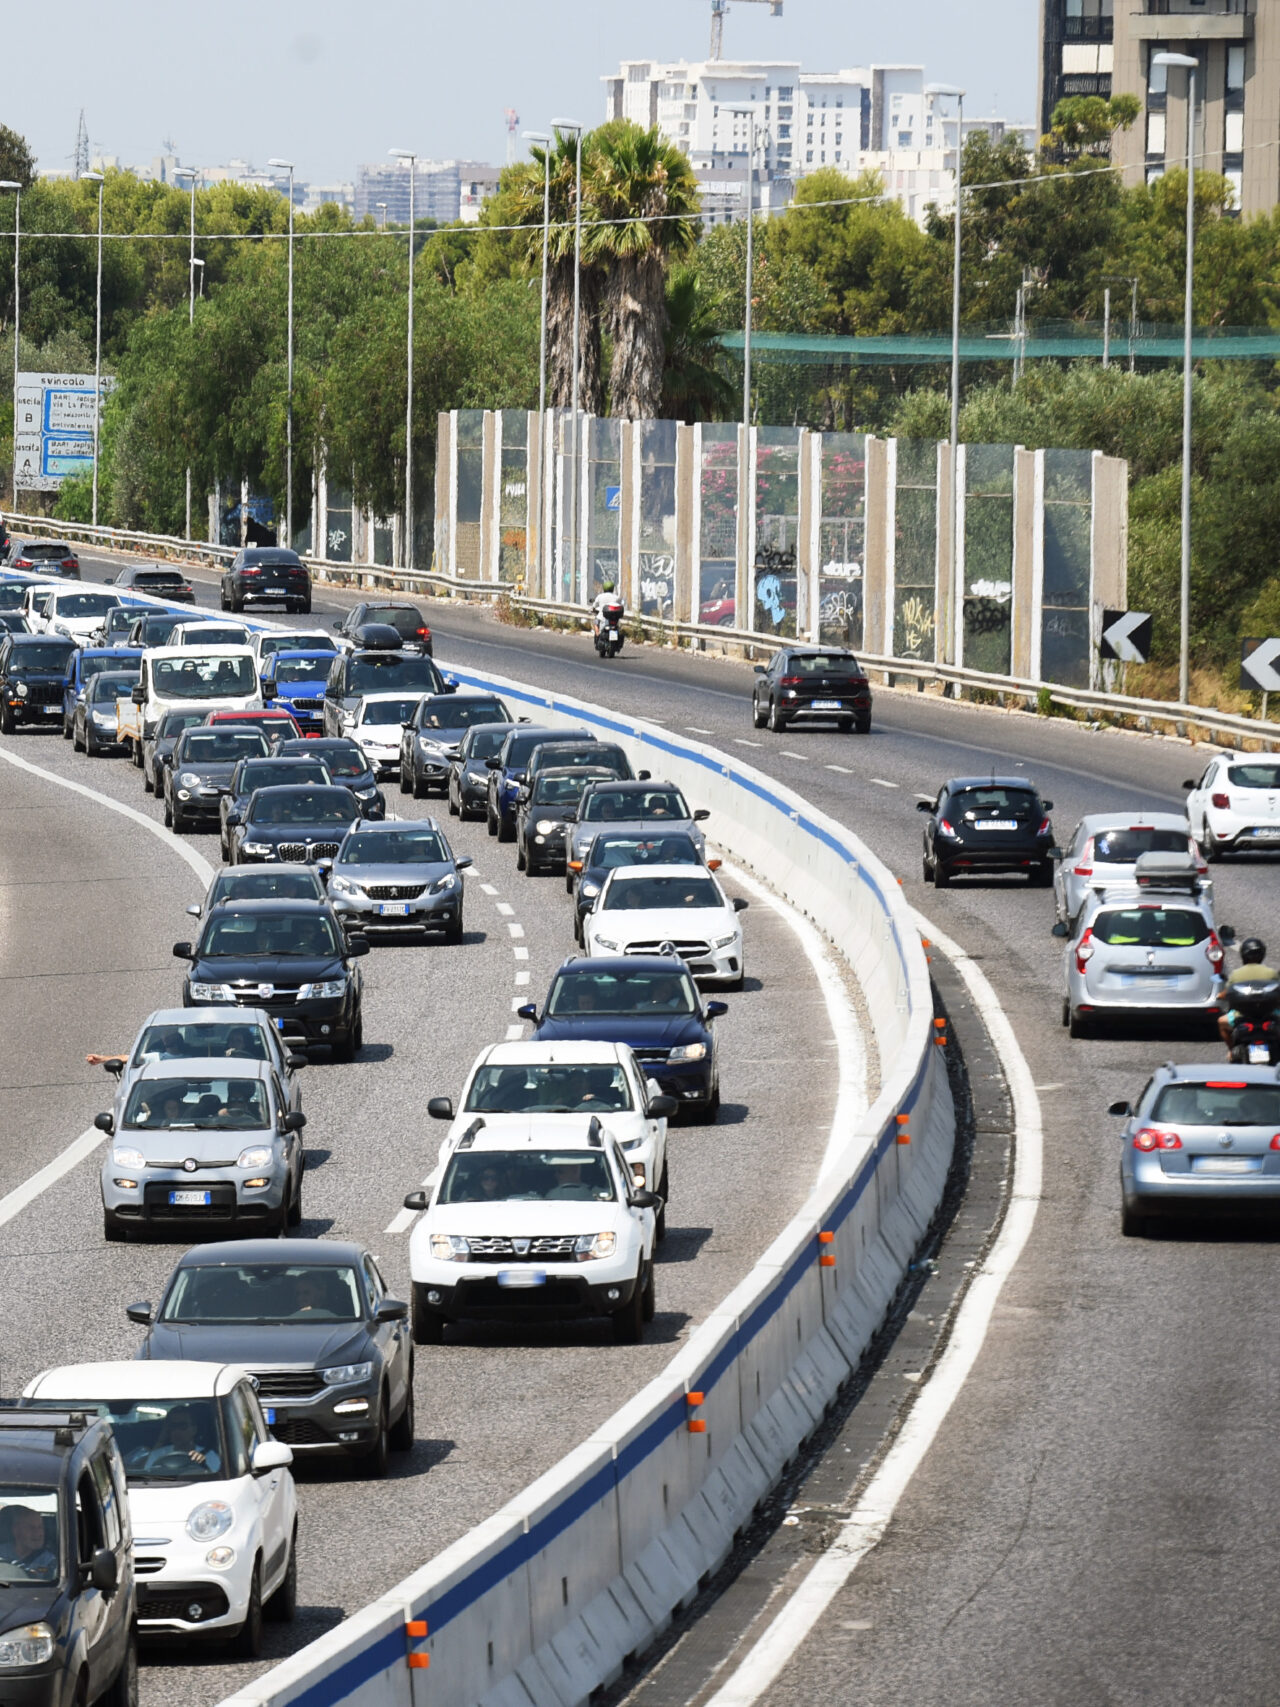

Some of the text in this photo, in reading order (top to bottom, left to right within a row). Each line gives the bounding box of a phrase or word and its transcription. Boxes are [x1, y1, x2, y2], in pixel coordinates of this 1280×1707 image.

[41, 377, 85, 386] svincolo
[24, 413, 33, 423] B
[16, 444, 40, 452] uscita
[23, 458, 32, 467] A
